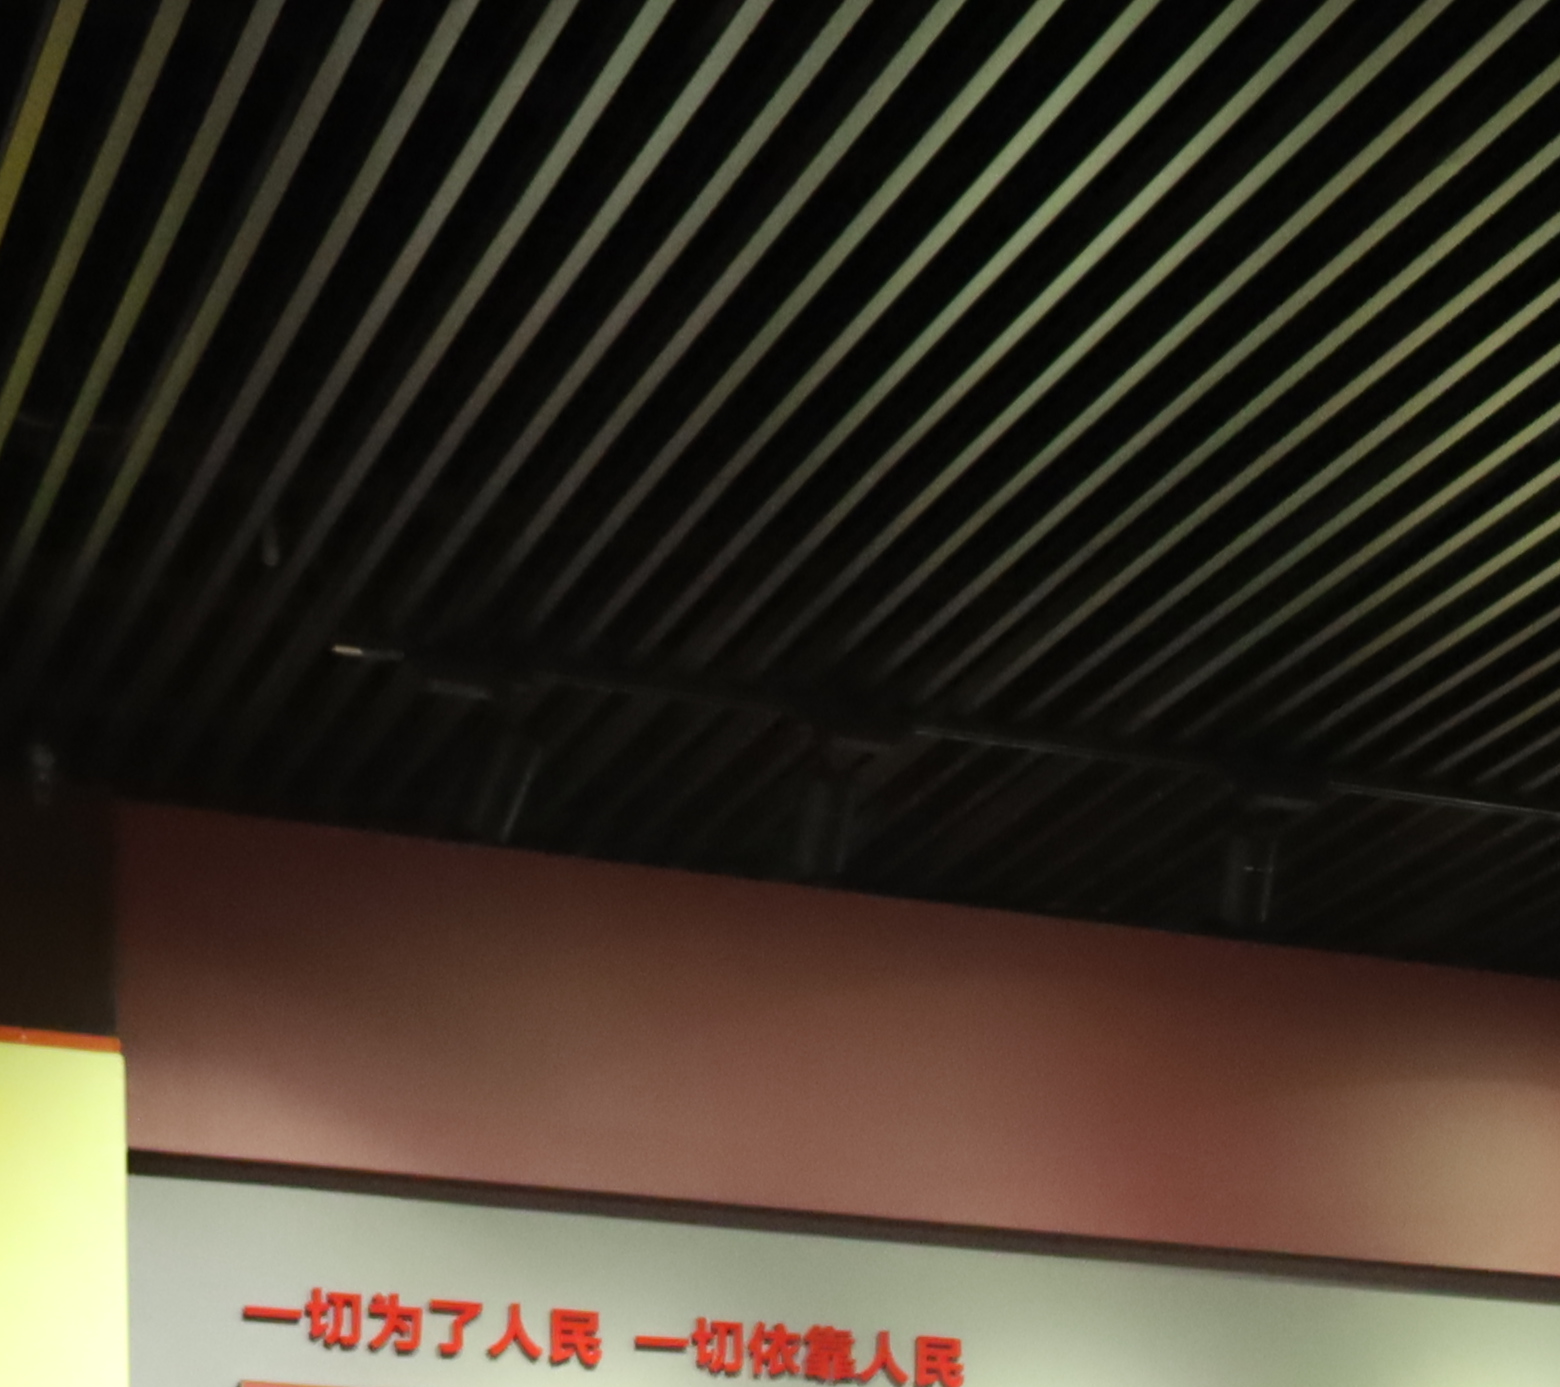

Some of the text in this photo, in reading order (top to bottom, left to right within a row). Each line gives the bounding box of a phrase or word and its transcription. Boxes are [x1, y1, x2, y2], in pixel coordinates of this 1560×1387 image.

[243, 1287, 604, 1367] 一切为了人民
